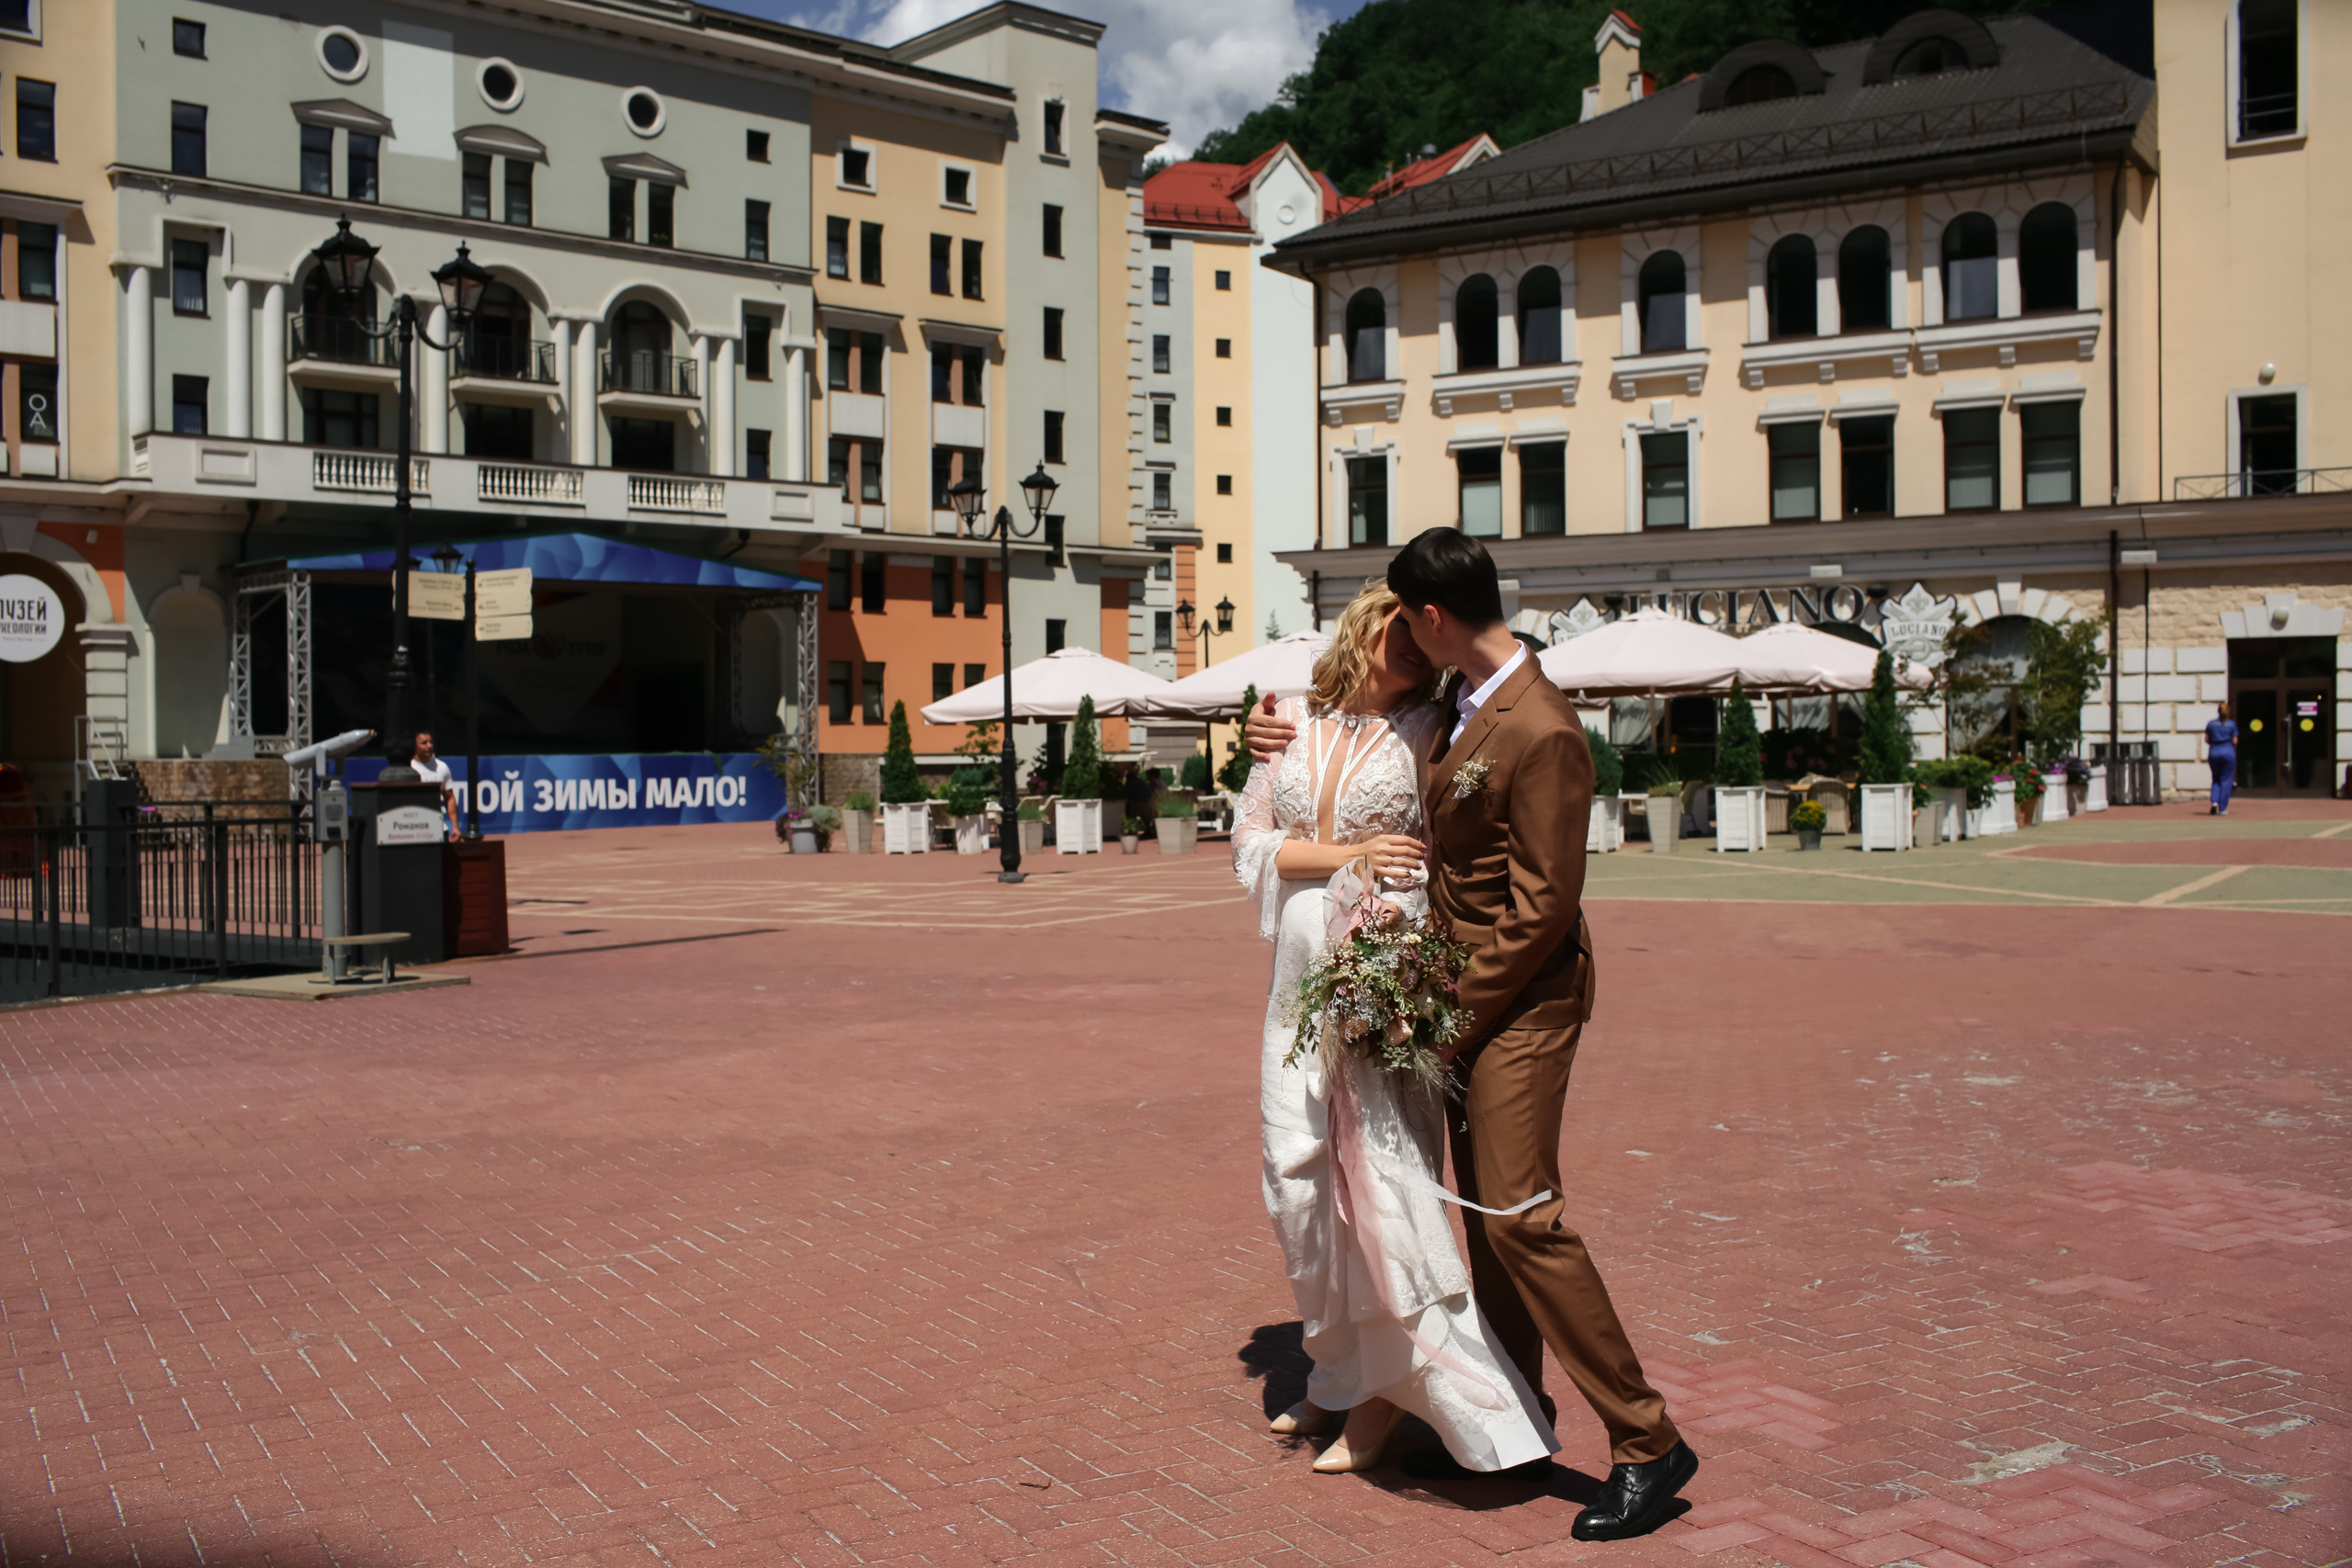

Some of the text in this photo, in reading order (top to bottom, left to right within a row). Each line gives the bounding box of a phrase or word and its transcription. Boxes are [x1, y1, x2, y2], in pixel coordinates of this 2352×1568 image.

[1891, 623, 1947, 637] LUCIANO
[533, 777, 638, 813] ЗИМЫ
[645, 775, 747, 809] МАЛО!
[393, 821, 429, 830] Романов
